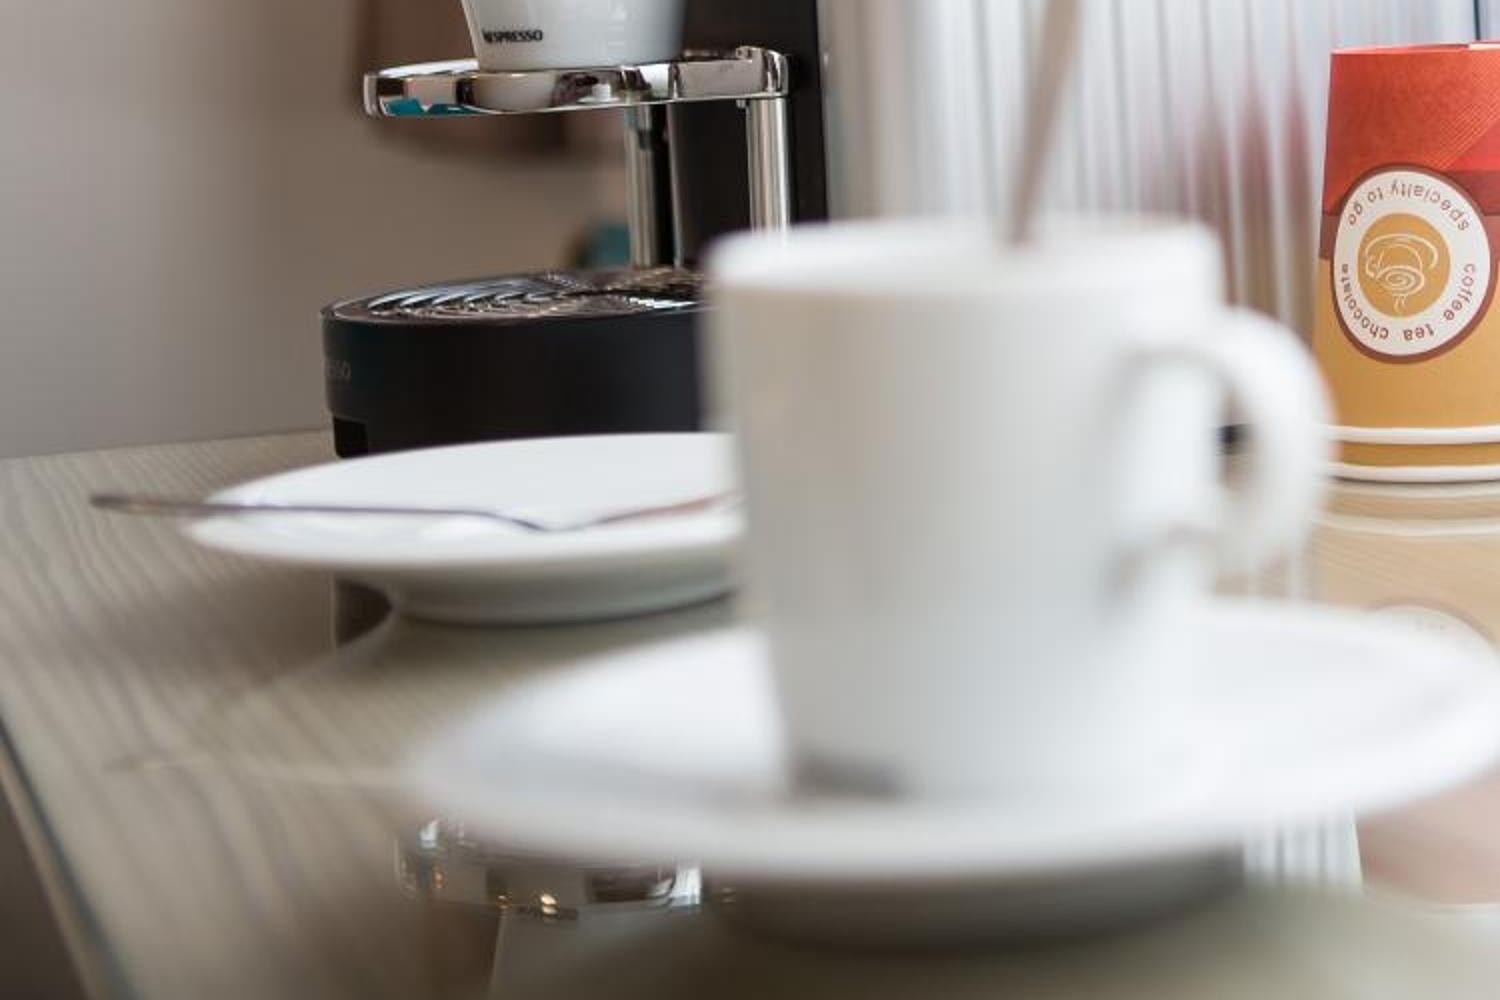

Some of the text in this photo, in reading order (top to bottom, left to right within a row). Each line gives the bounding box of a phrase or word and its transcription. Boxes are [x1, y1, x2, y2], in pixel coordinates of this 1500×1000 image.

[1348, 180, 1470, 231] specialty to go
[1341, 263, 1476, 342] coffee tea chocolate
